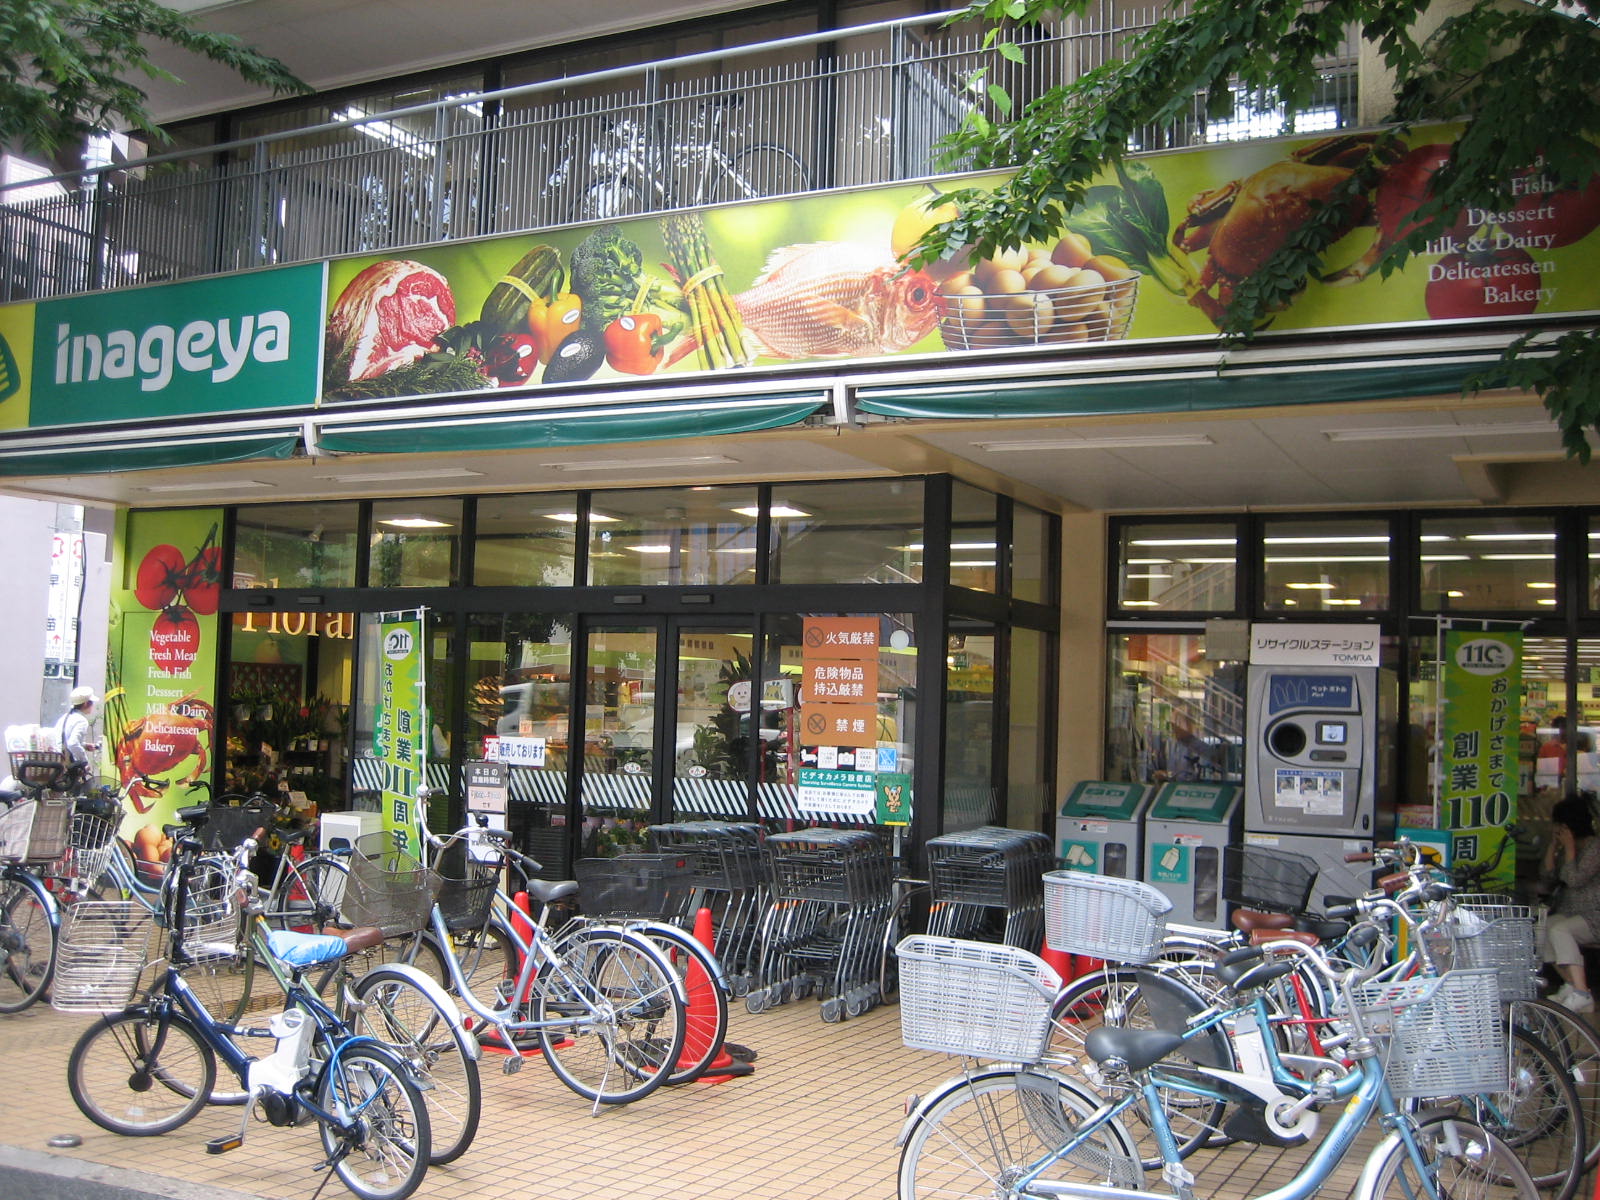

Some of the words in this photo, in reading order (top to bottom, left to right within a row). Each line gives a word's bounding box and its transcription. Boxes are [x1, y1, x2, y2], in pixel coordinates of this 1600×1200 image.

[1511, 175, 1555, 196] Fish
[1467, 206, 1555, 227] Desssert
[1466, 236, 1487, 252] &
[1495, 231, 1557, 251] Dairy
[1428, 259, 1556, 282] Delicatessen
[1484, 285, 1559, 305] Bakery
[55, 310, 291, 391] inageya
[150, 630, 191, 646] Vegetable
[825, 631, 875, 646] 火気厳禁
[1257, 639, 1374, 651] リサイクルステーション
[148, 648, 172, 661] Fresh
[174, 649, 197, 661] Meat
[1332, 653, 1373, 662] TOMRA
[147, 667, 171, 679] Fresh
[173, 667, 192, 680] Fish
[814, 666, 864, 680] 危険物品
[814, 682, 864, 697] 持込厳禁
[146, 703, 167, 716] Milk
[170, 704, 180, 716] &
[182, 704, 209, 720] Dairy
[145, 720, 200, 736] Delicatessen
[1489, 678, 1508, 788] おかげさまで
[144, 739, 175, 756] Bakery
